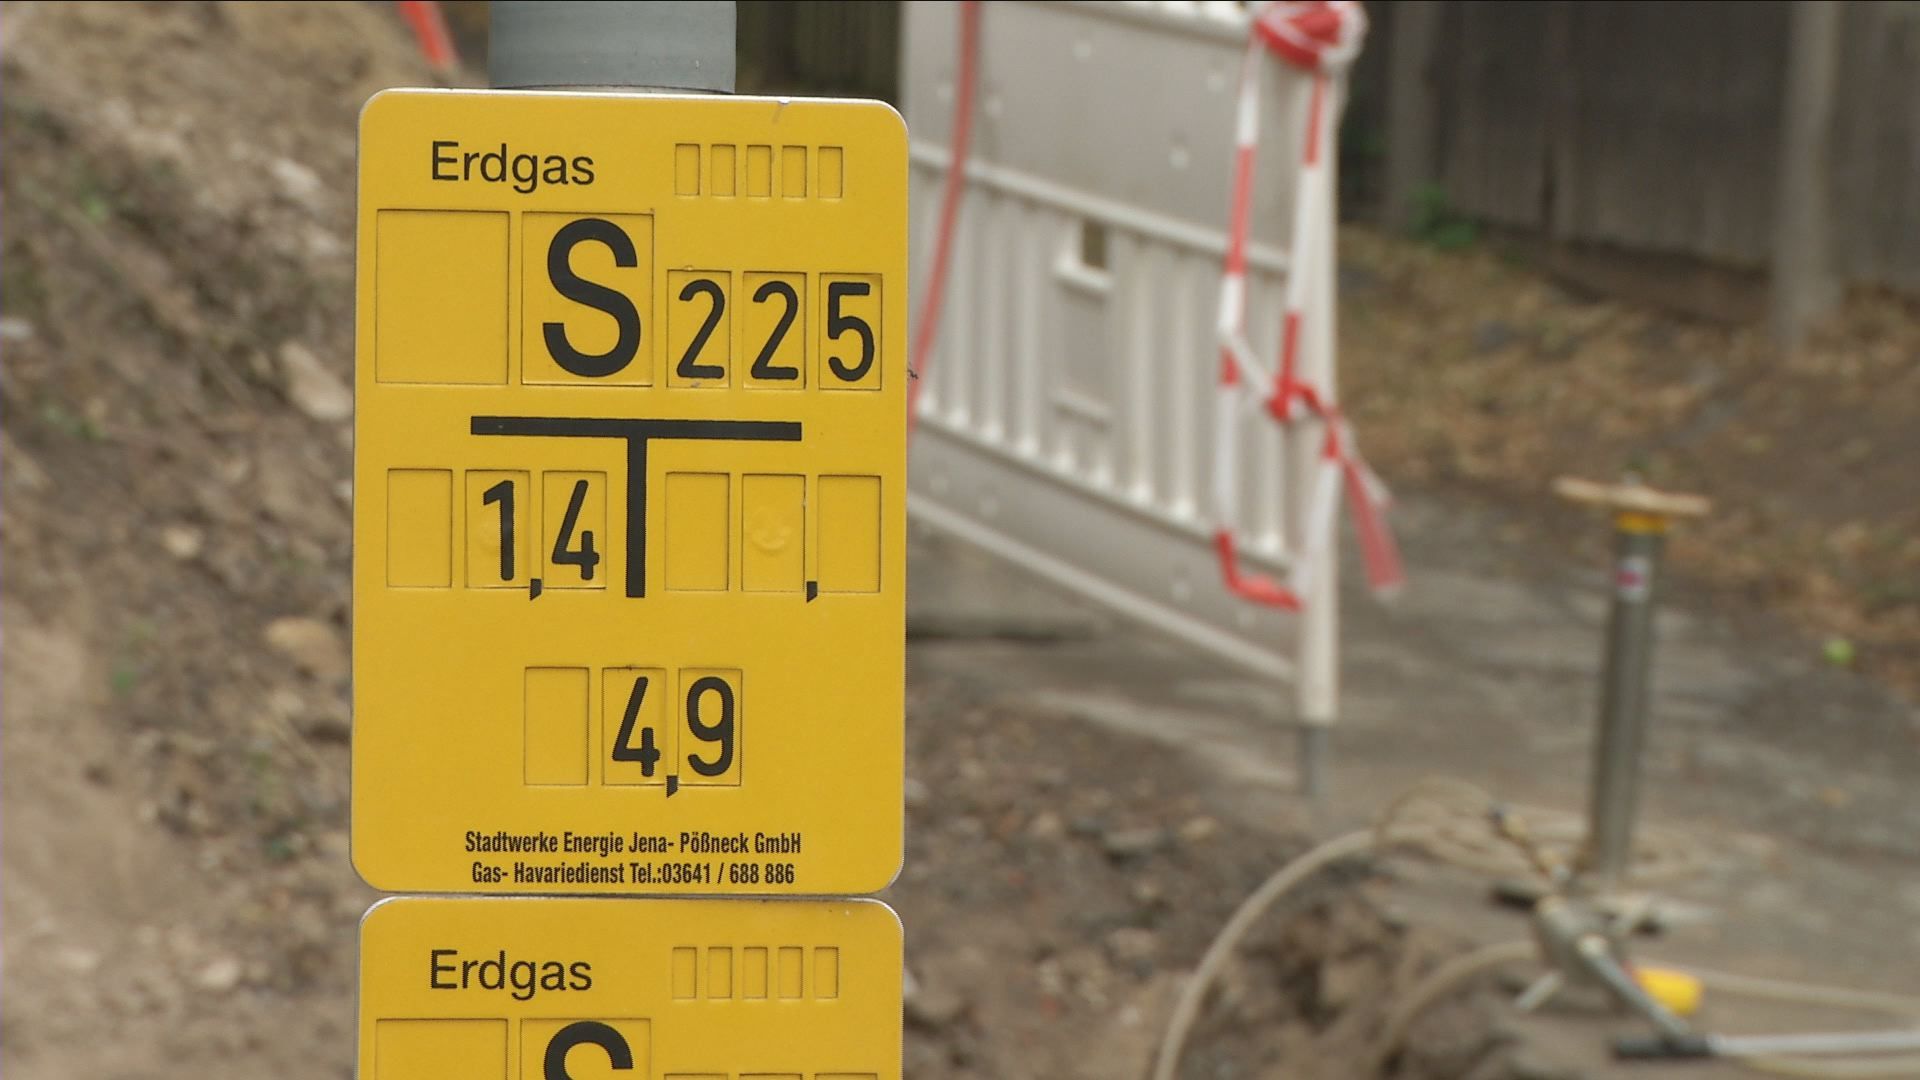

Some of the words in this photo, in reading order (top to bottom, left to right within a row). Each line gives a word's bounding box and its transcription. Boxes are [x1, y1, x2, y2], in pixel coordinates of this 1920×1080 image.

[430, 140, 595, 194] Erdgas
[541, 217, 642, 378] S
[675, 278, 875, 382] 225
[482, 479, 601, 601] 1,4
[611, 676, 735, 798] 4,9
[465, 831, 558, 854] Stadtwerke
[563, 831, 624, 858] Energie
[628, 831, 674, 854] Jena-
[679, 831, 749, 854] Pößneck
[754, 832, 801, 854] GmbH
[472, 861, 509, 884] Gas-
[514, 861, 625, 884] Havariedienst
[717, 862, 725, 884] /
[729, 863, 760, 884] 688
[764, 863, 795, 884] 886
[429, 949, 593, 1001] Erdgas
